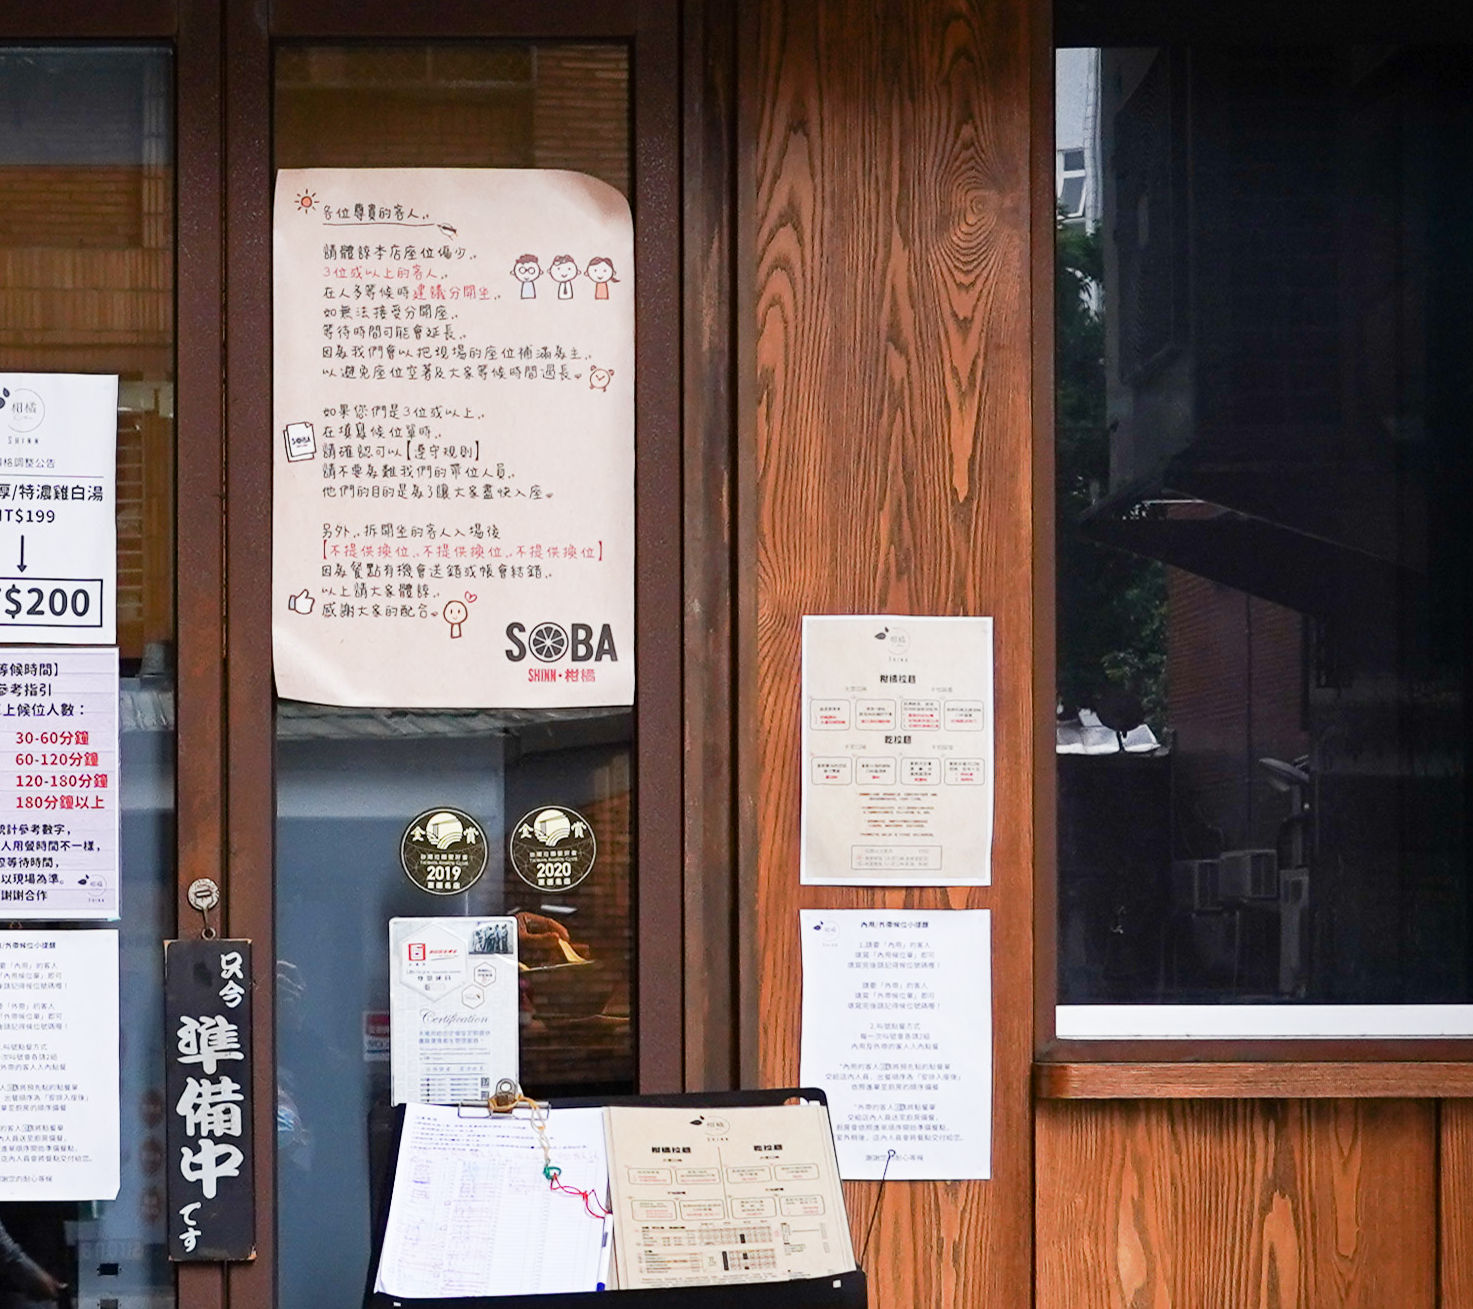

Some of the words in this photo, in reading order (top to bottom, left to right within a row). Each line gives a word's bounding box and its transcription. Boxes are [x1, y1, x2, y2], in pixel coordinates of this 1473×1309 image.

[505, 621, 618, 664] SOBA
[16, 732, 89, 745] 30-60分鐘
[16, 753, 99, 766] 60-120分鐘
[16, 774, 108, 787] 120-180分鐘
[16, 796, 105, 809] 180分鐘以上
[426, 865, 462, 881] 2019
[536, 862, 572, 878] 2020
[176, 1015, 244, 1199] 準備中
[179, 1201, 202, 1252] です
